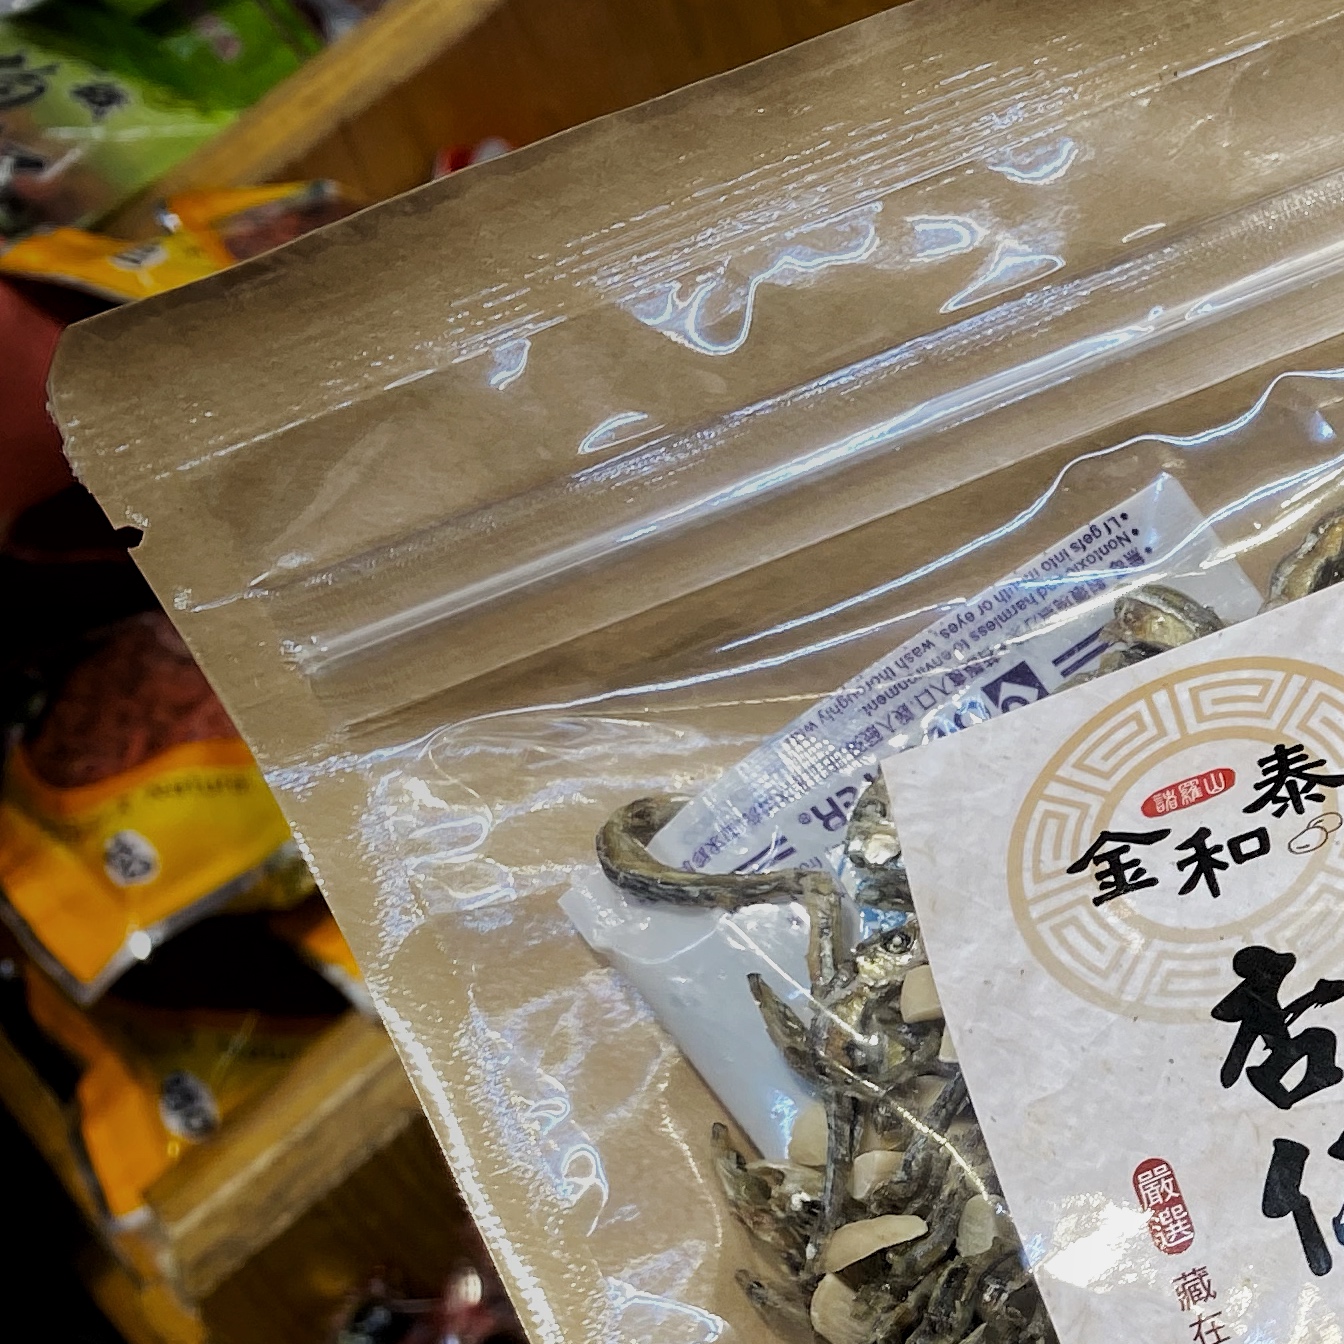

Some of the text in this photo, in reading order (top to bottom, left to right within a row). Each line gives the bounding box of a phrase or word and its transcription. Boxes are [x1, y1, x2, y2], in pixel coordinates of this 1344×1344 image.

[1038, 547, 1072, 576] into
[967, 592, 1040, 646] harmless
[892, 637, 938, 673] wash
[1152, 771, 1226, 814] 諸羅山
[1137, 1163, 1195, 1251] 嚴選
